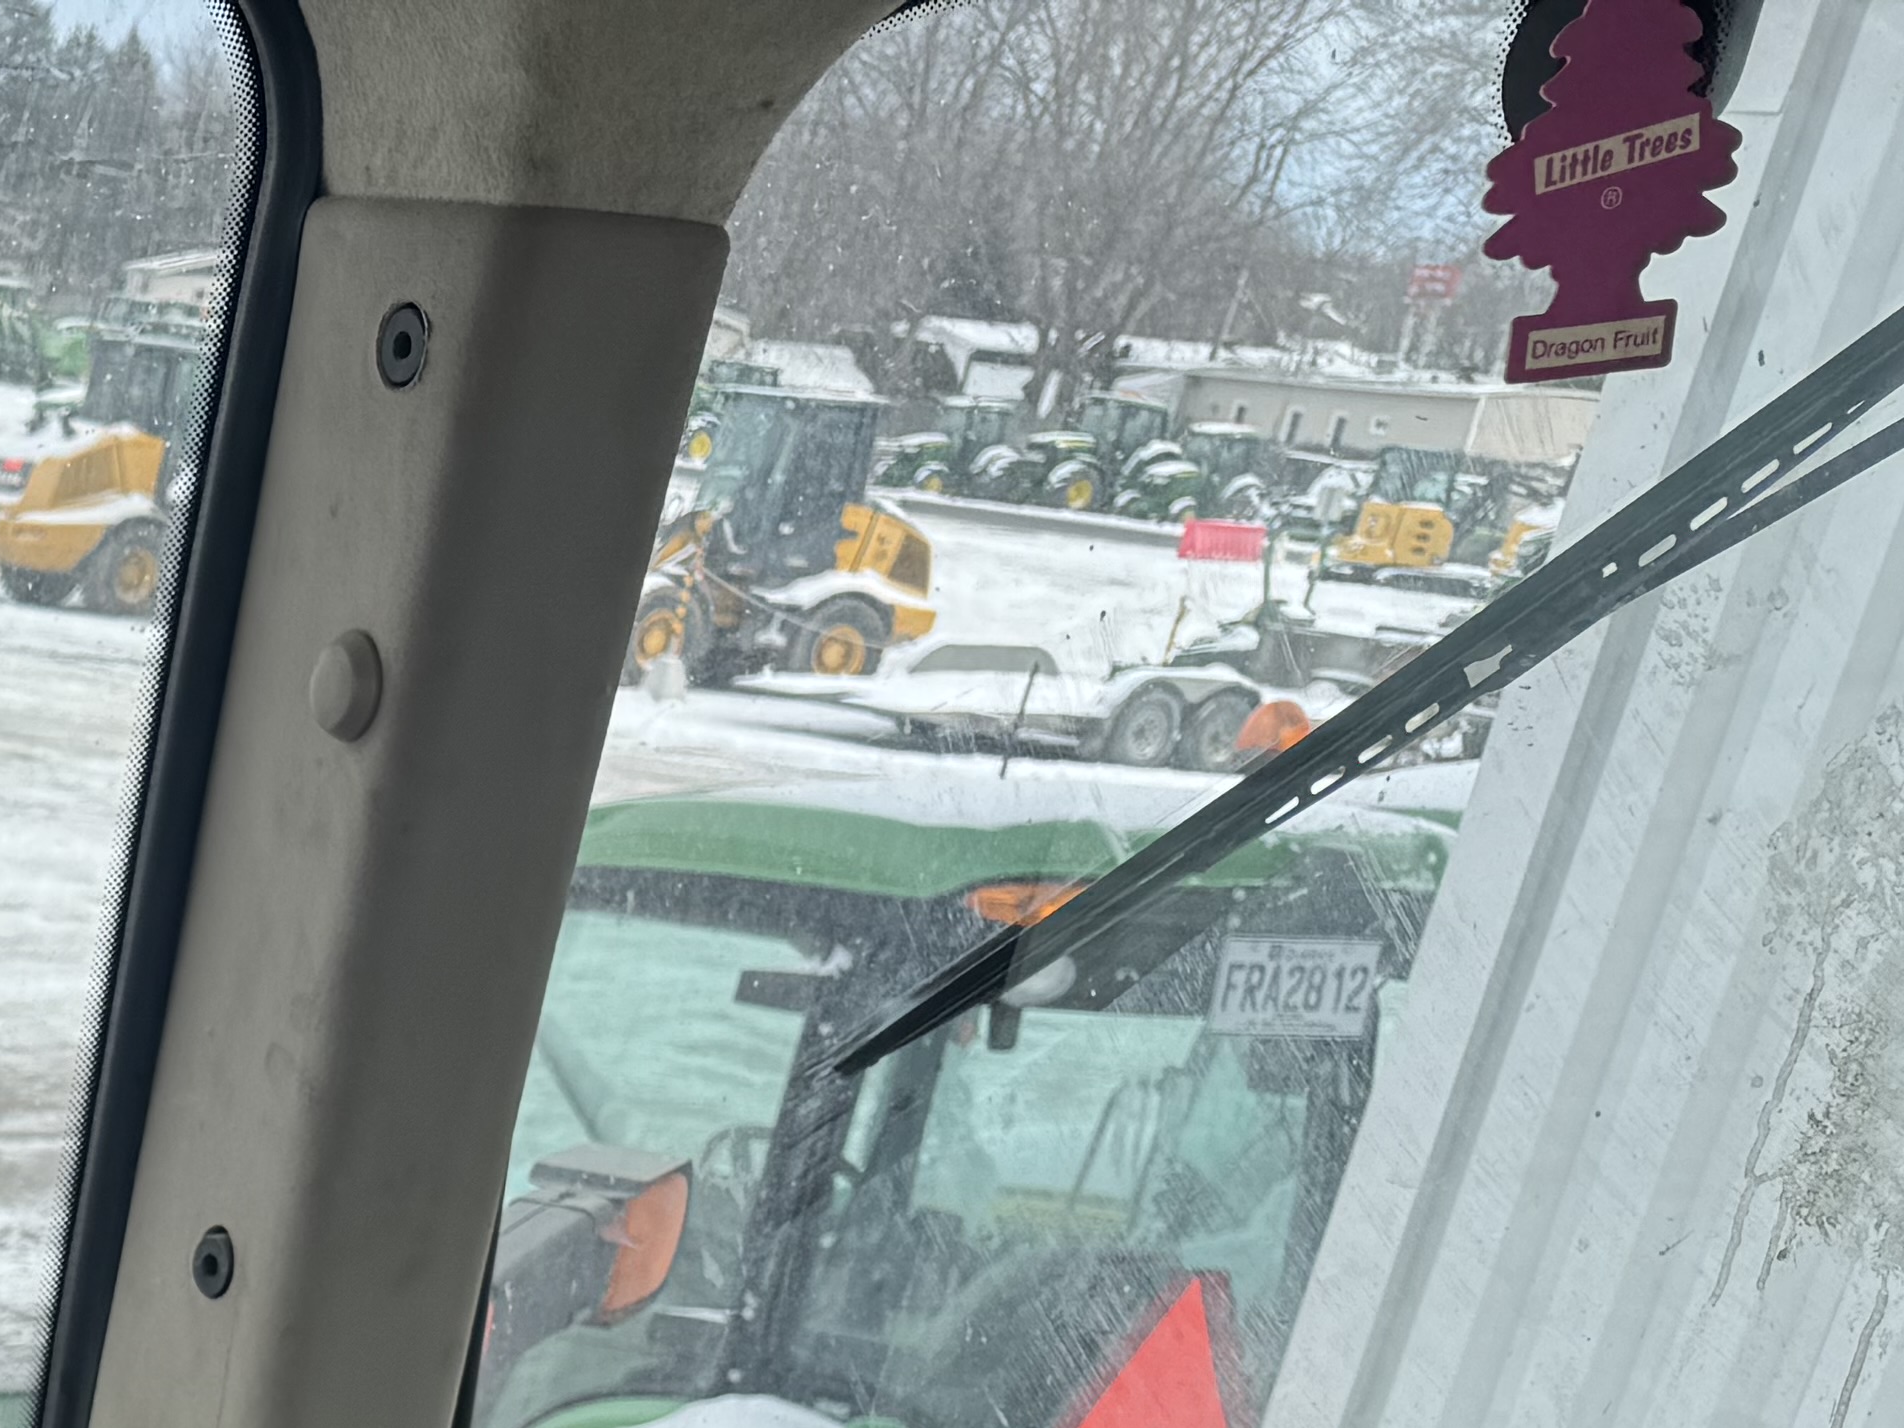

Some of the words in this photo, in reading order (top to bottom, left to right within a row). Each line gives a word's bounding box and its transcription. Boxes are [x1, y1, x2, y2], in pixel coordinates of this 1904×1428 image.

[1544, 144, 1613, 189] Little
[1622, 127, 1693, 165] Trees
[1530, 336, 1606, 361] Dragon
[1613, 326, 1659, 350] Fruit
[1220, 963, 1370, 1014] FRA2812
